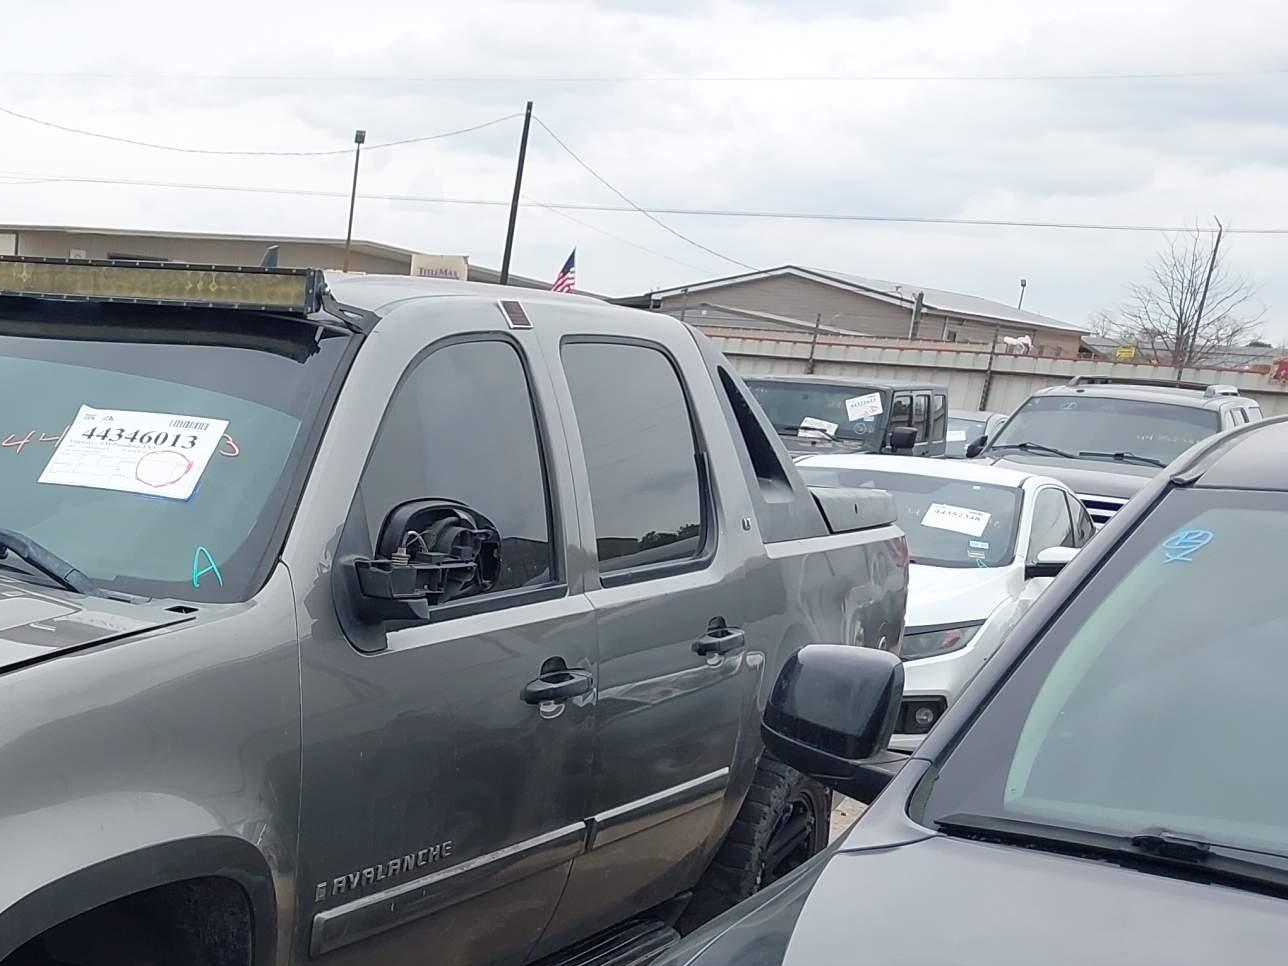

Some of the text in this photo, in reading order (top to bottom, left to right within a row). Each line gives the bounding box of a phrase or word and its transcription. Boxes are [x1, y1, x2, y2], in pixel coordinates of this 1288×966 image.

[81, 426, 199, 449] 44346013
[192, 546, 223, 588] A
[332, 840, 454, 896] AVALANCHE
